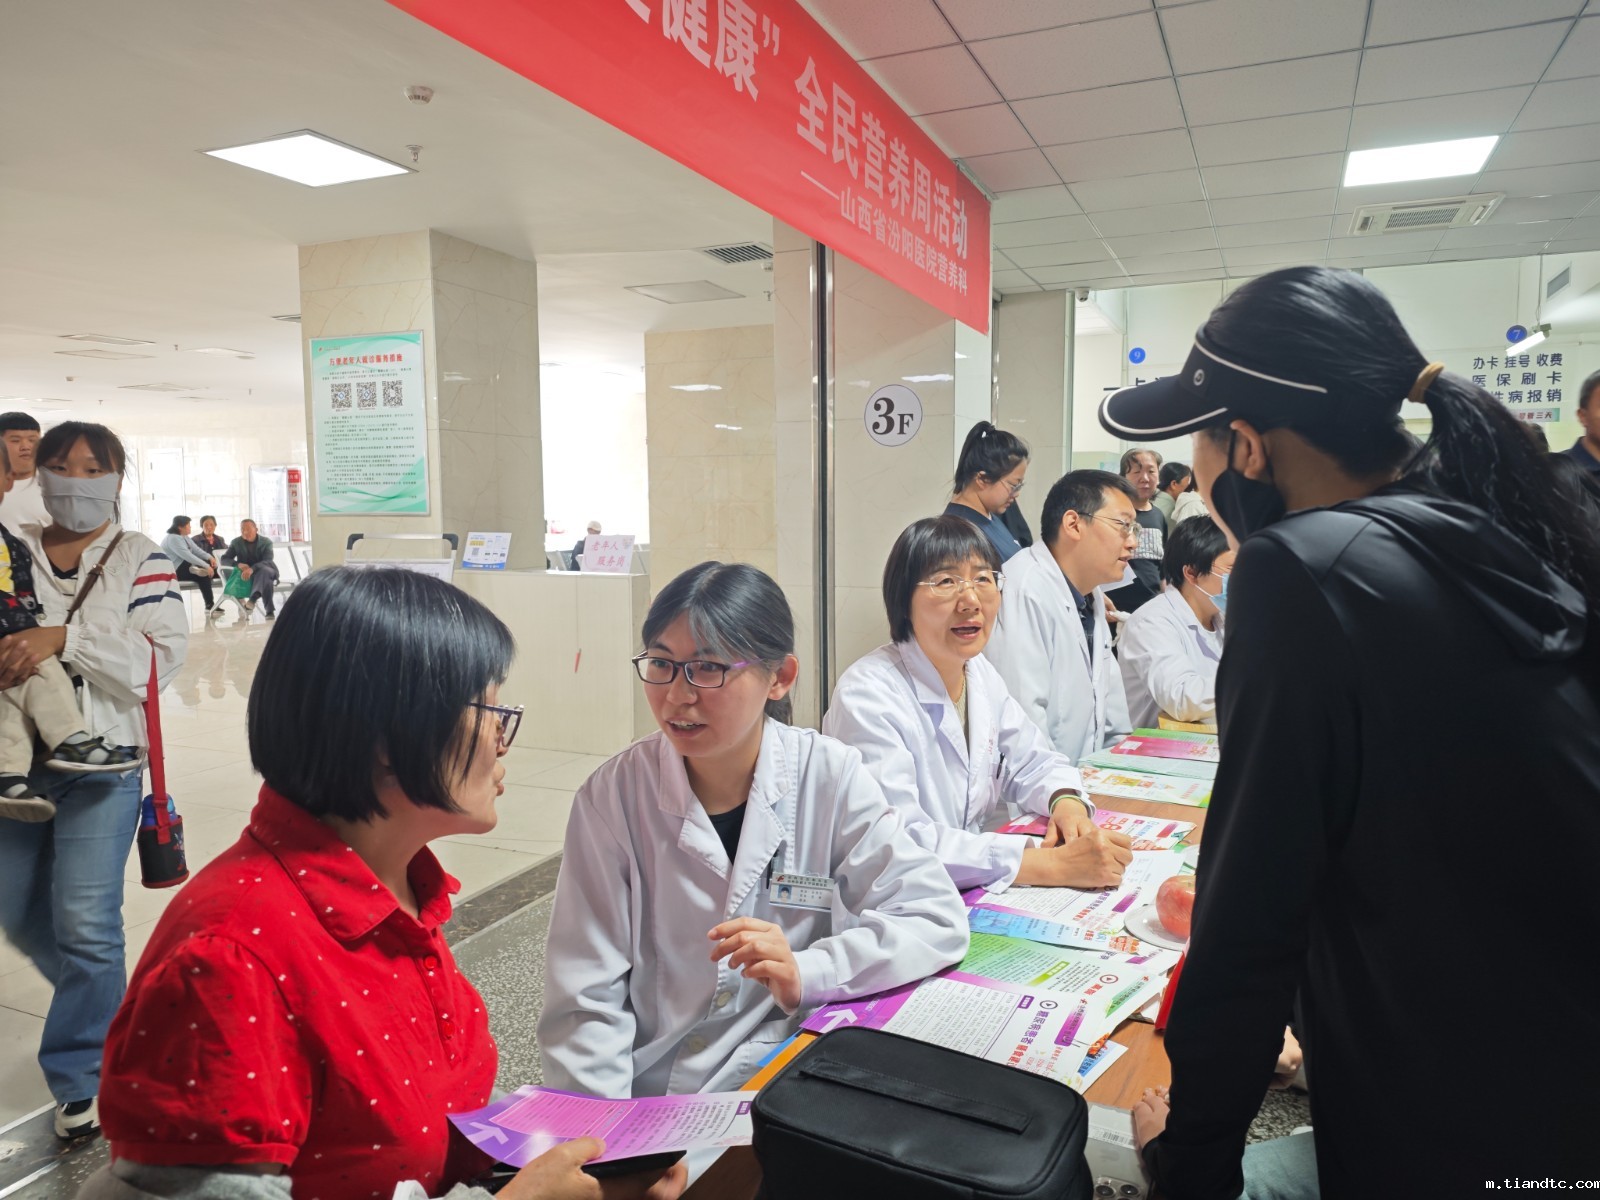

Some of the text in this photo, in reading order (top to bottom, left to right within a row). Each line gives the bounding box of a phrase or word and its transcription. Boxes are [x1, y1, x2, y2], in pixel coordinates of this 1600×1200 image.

[795, 56, 968, 260] 全民营养周活动
[1473, 353, 1563, 370] 办卡 挂号 收费
[872, 397, 914, 435] 3F
